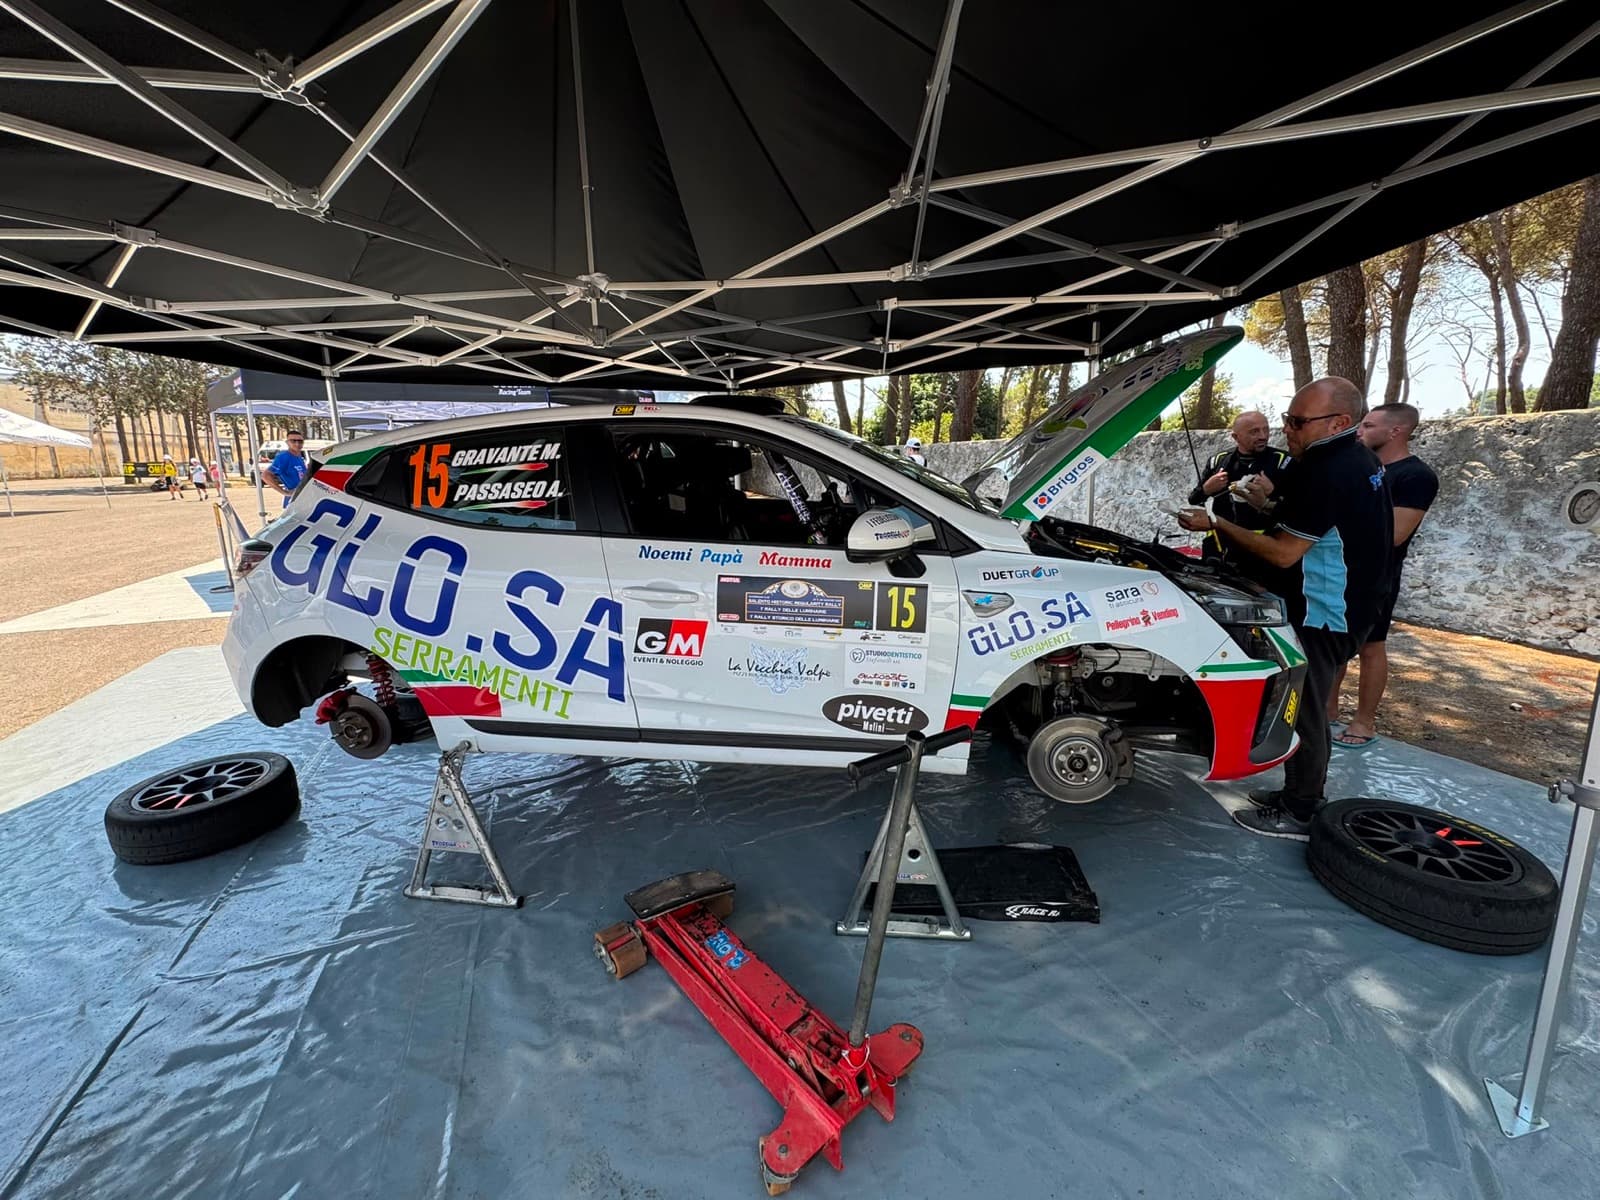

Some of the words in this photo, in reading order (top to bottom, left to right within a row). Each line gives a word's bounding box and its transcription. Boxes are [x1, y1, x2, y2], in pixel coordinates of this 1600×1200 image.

[615, 406, 634, 414] OMP
[451, 444, 539, 467] GRAVANTE
[539, 443, 562, 460] M.
[409, 444, 451, 510] 15
[1047, 456, 1095, 496] Brigros
[453, 480, 547, 502] PASSASEO
[545, 480, 563, 498] A.
[638, 545, 693, 562] Noemi
[700, 549, 744, 566] Papà
[759, 551, 832, 569] Mamma
[270, 499, 626, 703] GLO.SA
[1105, 584, 1142, 604] sara
[887, 586, 917, 629] 15
[1105, 616, 1141, 632] Pellegrino
[1151, 607, 1180, 623] Vending
[967, 591, 1092, 656] GLO.SA
[637, 631, 700, 656] GM
[1009, 632, 1073, 661] SERRAMENTI
[371, 626, 574, 720] SERRAMENTI
[633, 656, 659, 664] EVENTI
[666, 658, 704, 666] NOLEGGIO
[728, 657, 741, 671] La
[746, 658, 793, 675] Vecchia
[797, 661, 832, 681] Volpe
[836, 700, 915, 725] pivetti
[1020, 908, 1048, 916] RACE
